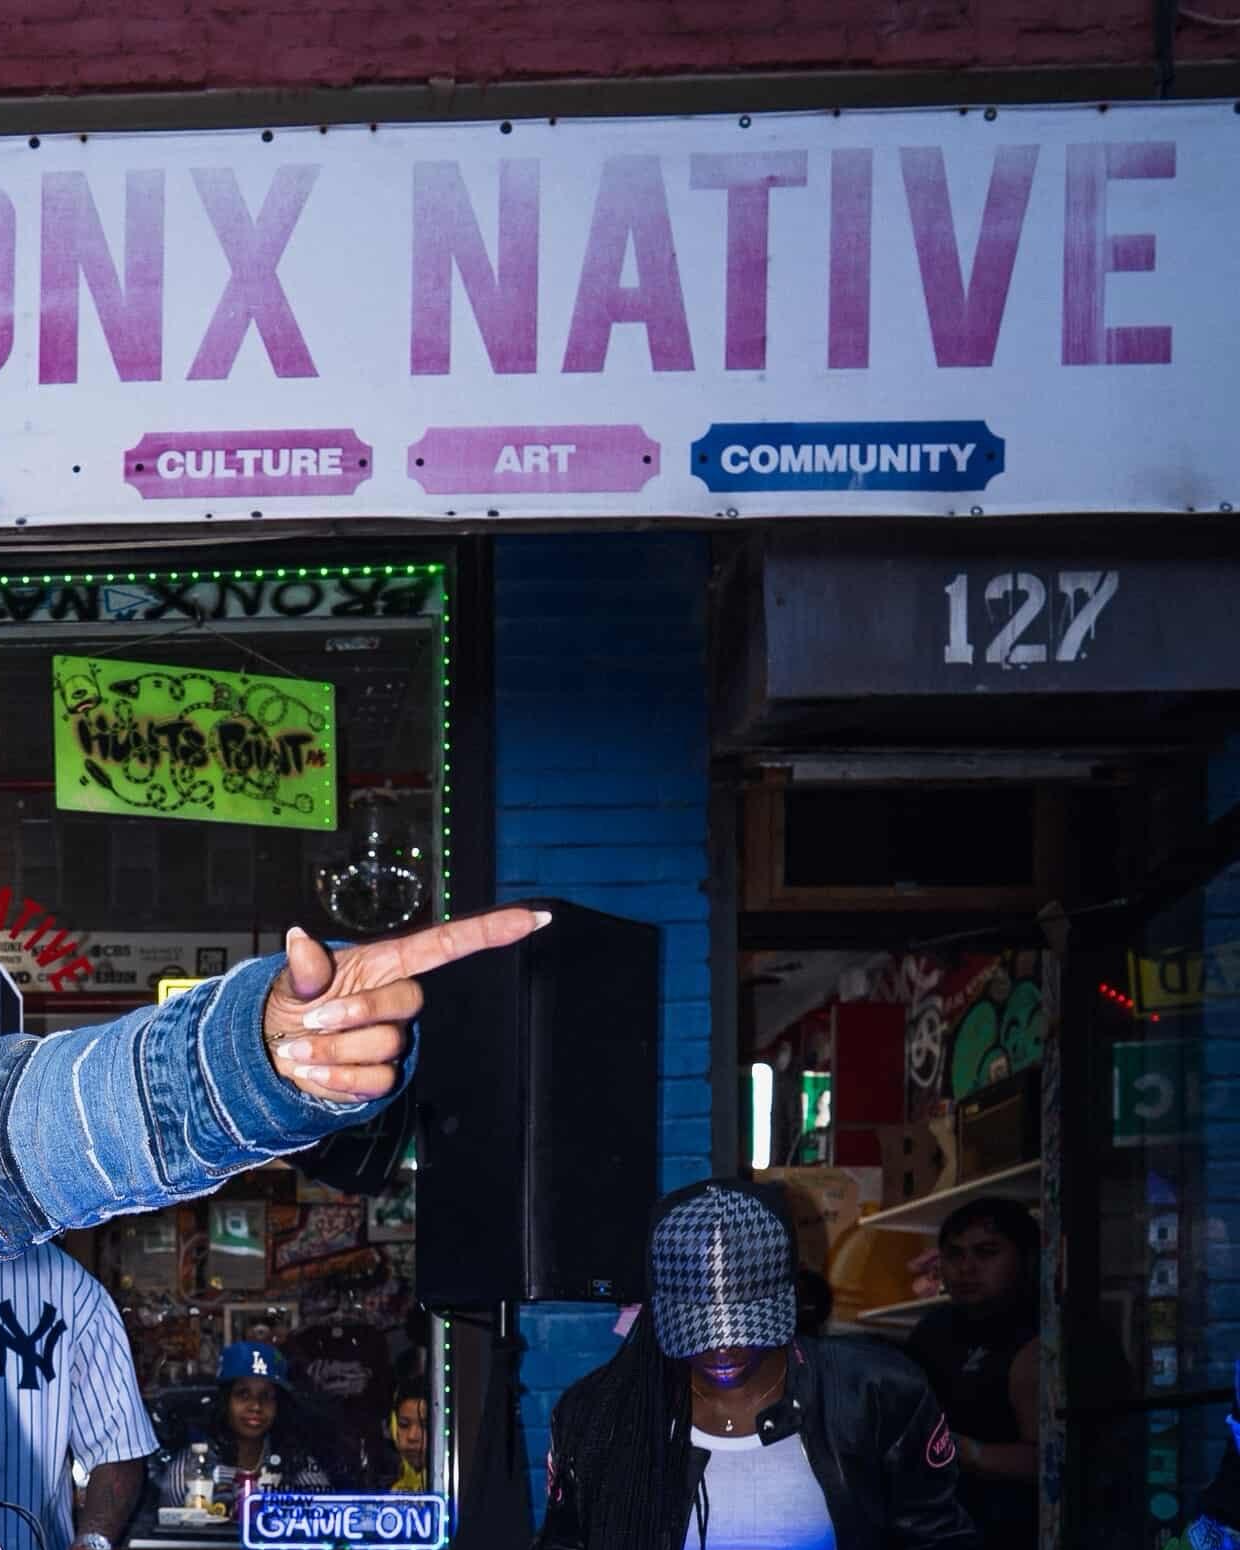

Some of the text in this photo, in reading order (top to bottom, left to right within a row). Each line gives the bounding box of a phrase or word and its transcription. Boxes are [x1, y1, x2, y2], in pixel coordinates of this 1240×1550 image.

[410, 141, 1176, 375] NATIVE
[157, 447, 343, 480] CULTURE
[495, 445, 575, 474] ART
[720, 442, 976, 475] COMMUNITY
[944, 570, 1119, 667] 127
[251, 1350, 268, 1375] LA
[256, 1506, 431, 1540] GAME ON
